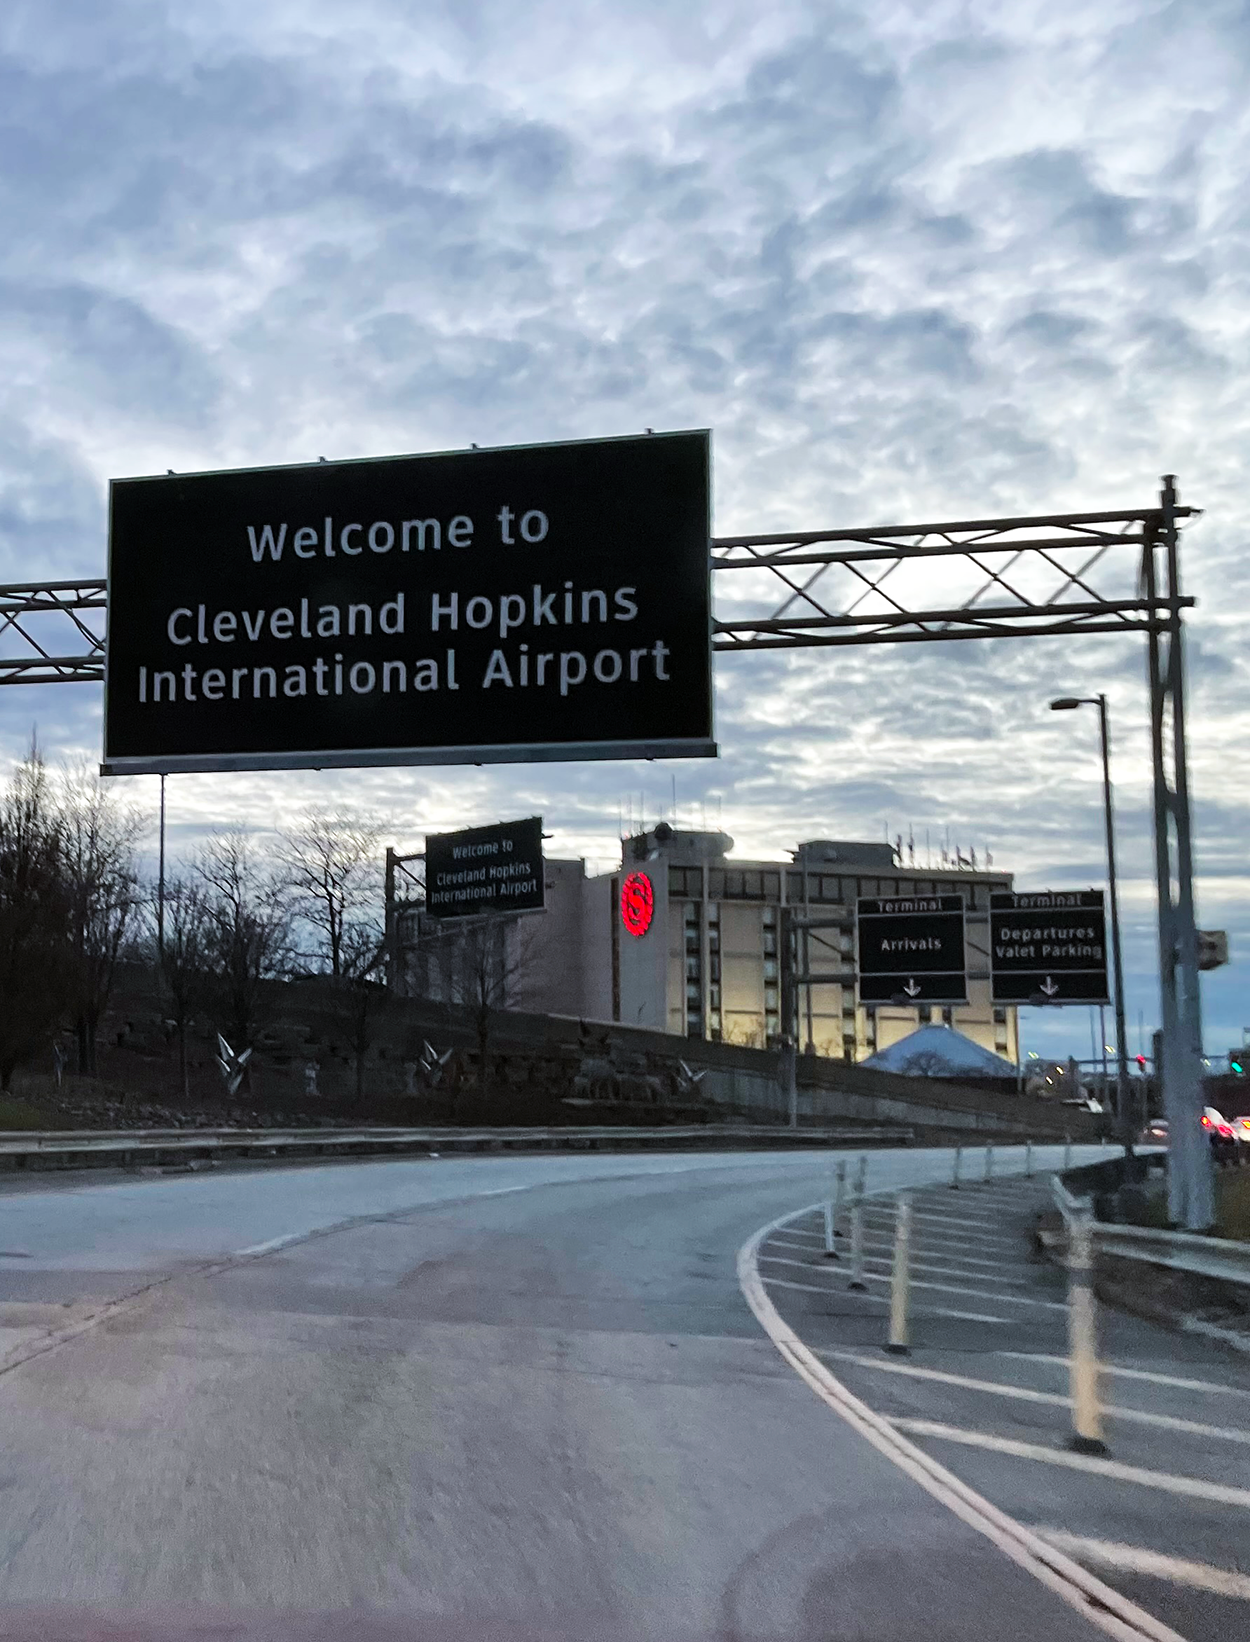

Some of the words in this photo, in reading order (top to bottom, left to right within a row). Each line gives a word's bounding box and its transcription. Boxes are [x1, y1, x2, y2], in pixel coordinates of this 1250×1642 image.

[247, 514, 475, 563] Welcome
[496, 504, 550, 546] to
[166, 592, 406, 646] Cleveland
[430, 580, 639, 639] Hopkins
[138, 648, 460, 703] International
[482, 640, 671, 697] Airport
[452, 841, 499, 860] Welcome
[502, 839, 514, 854] to
[436, 867, 486, 886] Cleveland
[489, 862, 531, 880] Hopkins
[431, 885, 497, 905] International
[500, 878, 537, 898] Airport
[1011, 893, 1082, 908] Terminal
[877, 898, 943, 913] Terminal
[881, 936, 942, 952] Arrivals
[1001, 926, 1095, 943] Departures
[995, 944, 1036, 959] Valet
[1041, 943, 1103, 961] Parking
